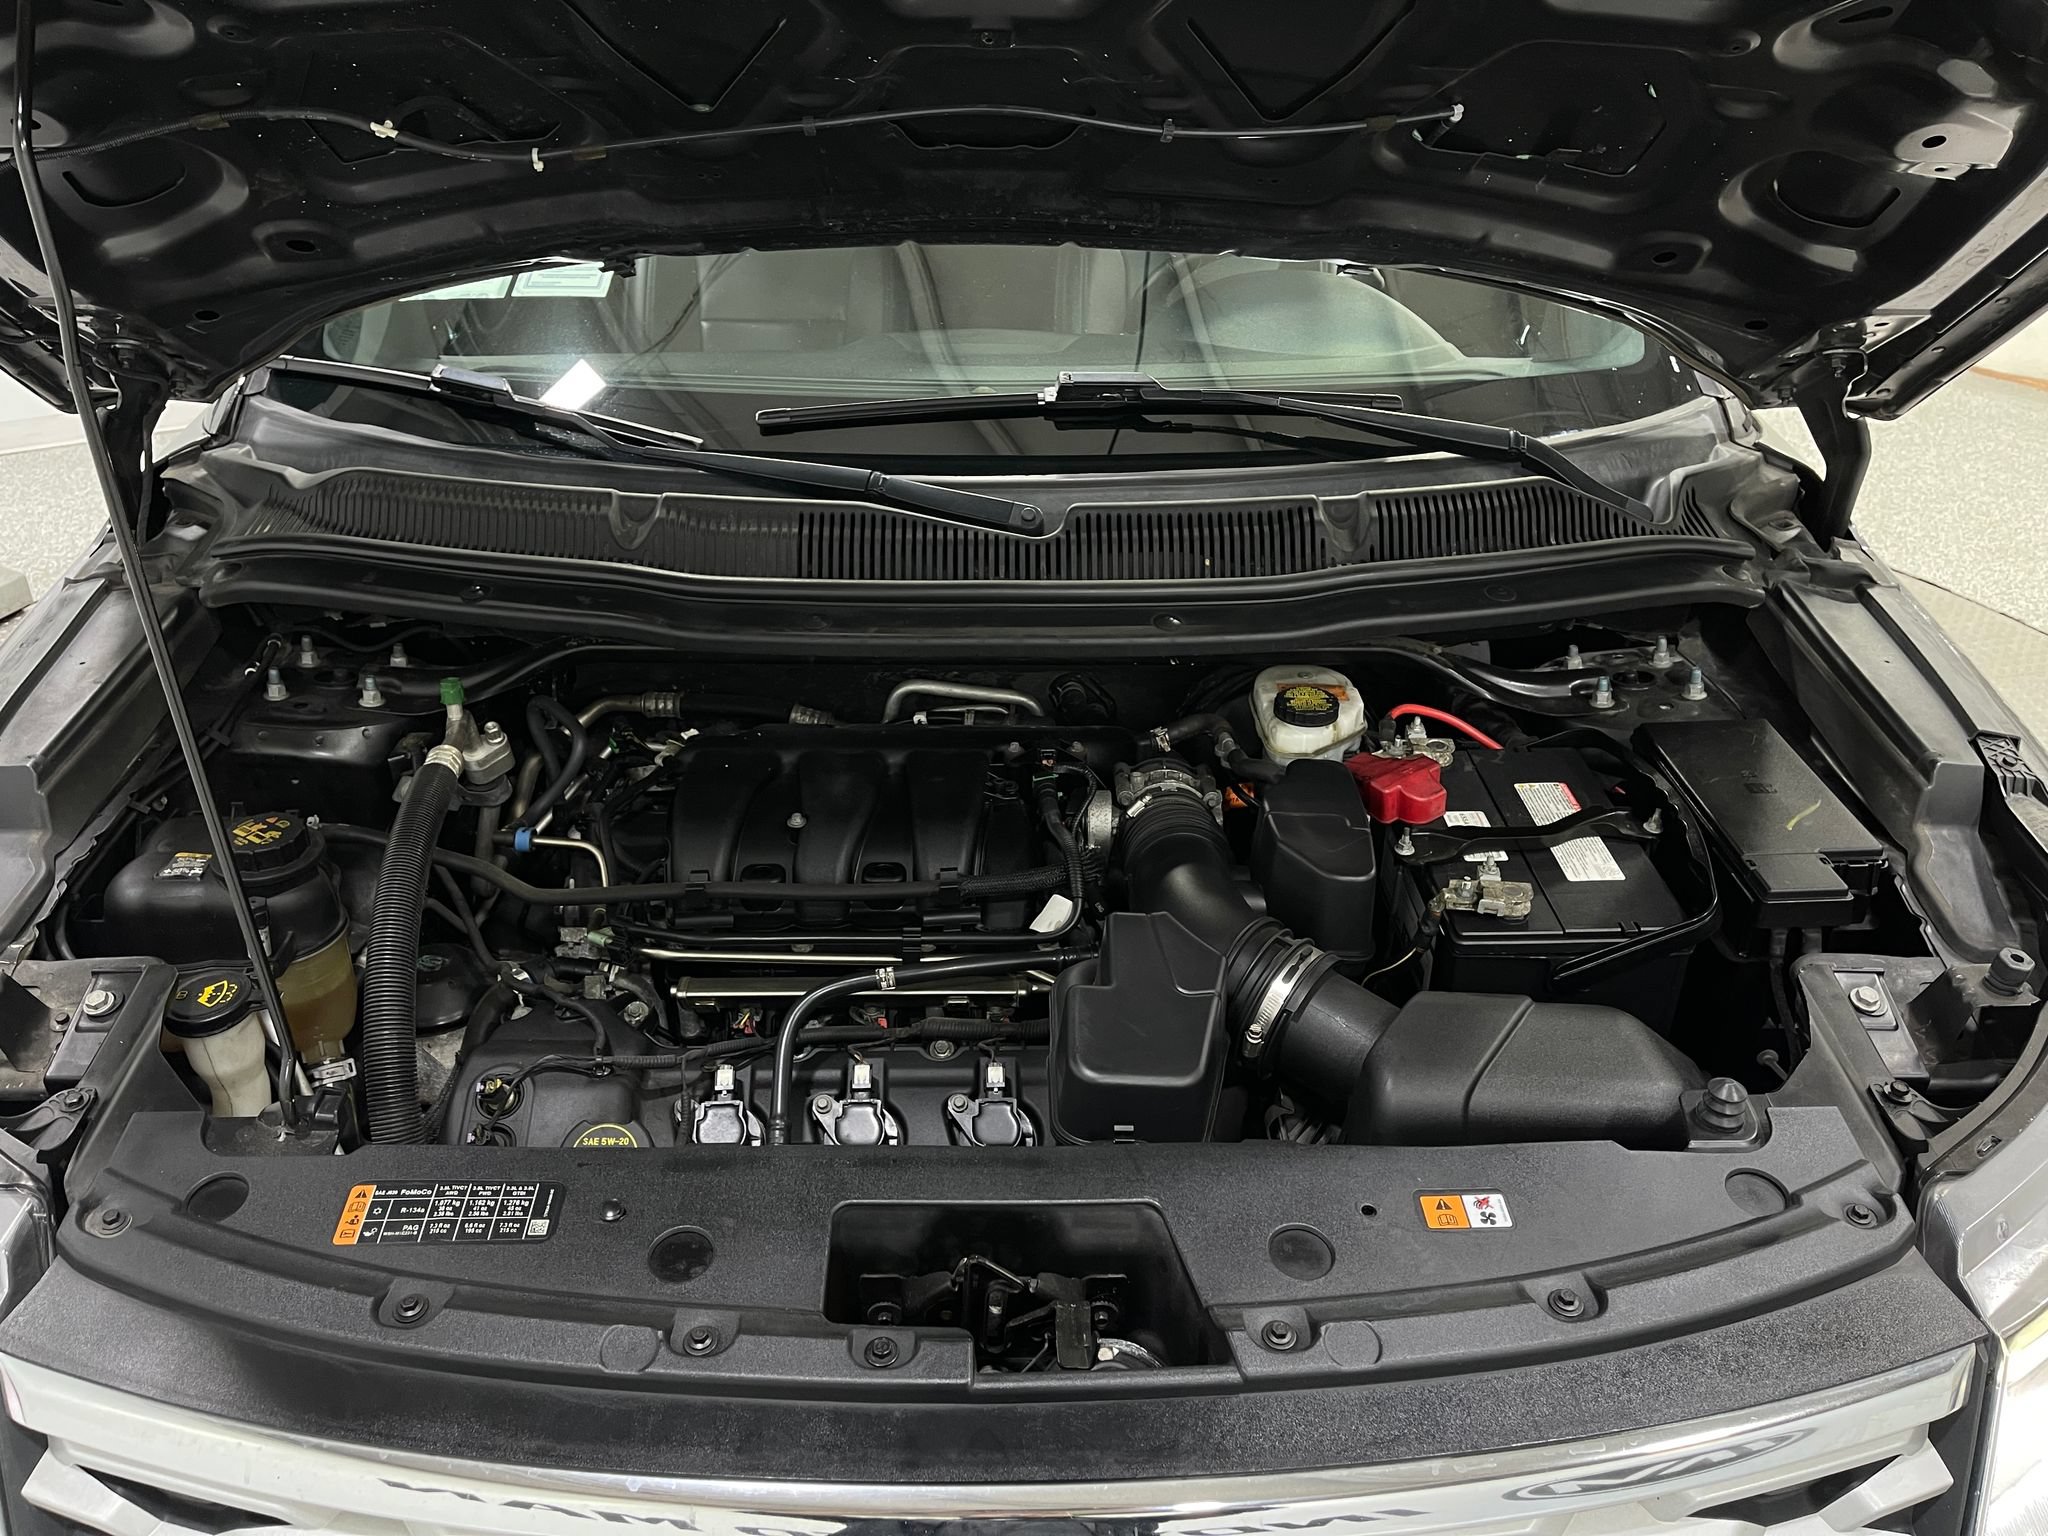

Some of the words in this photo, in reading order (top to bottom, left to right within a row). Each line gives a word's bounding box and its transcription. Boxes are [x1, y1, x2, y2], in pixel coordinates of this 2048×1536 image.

[582, 1137, 600, 1146] SAE
[601, 1137, 629, 1146] 5W-20
[400, 1188, 433, 1196] FoMoCo
